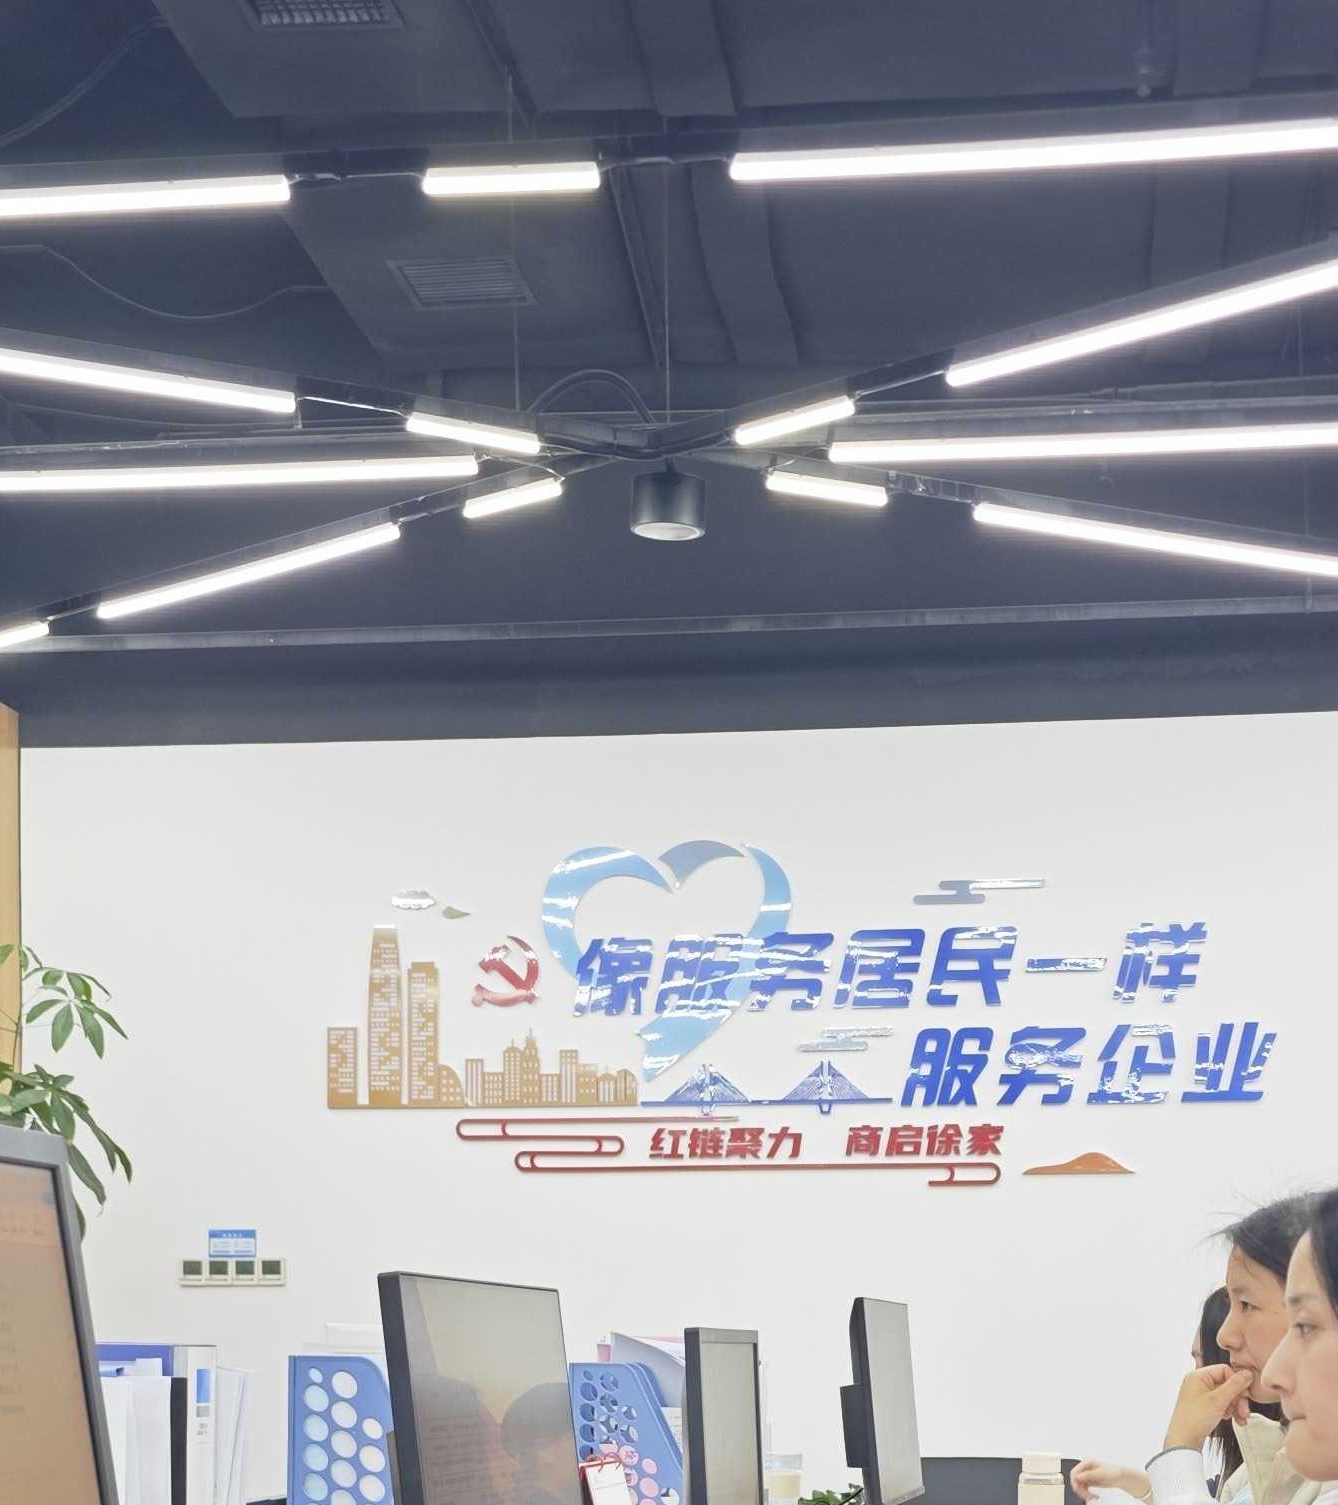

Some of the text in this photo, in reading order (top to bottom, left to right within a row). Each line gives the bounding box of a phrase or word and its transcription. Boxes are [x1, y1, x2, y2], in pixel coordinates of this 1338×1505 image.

[573, 922, 1209, 1016] 像服务居民一样
[899, 1021, 1278, 1109] 服务企业
[648, 1124, 1003, 1160] 红链聚力 商启徐家
